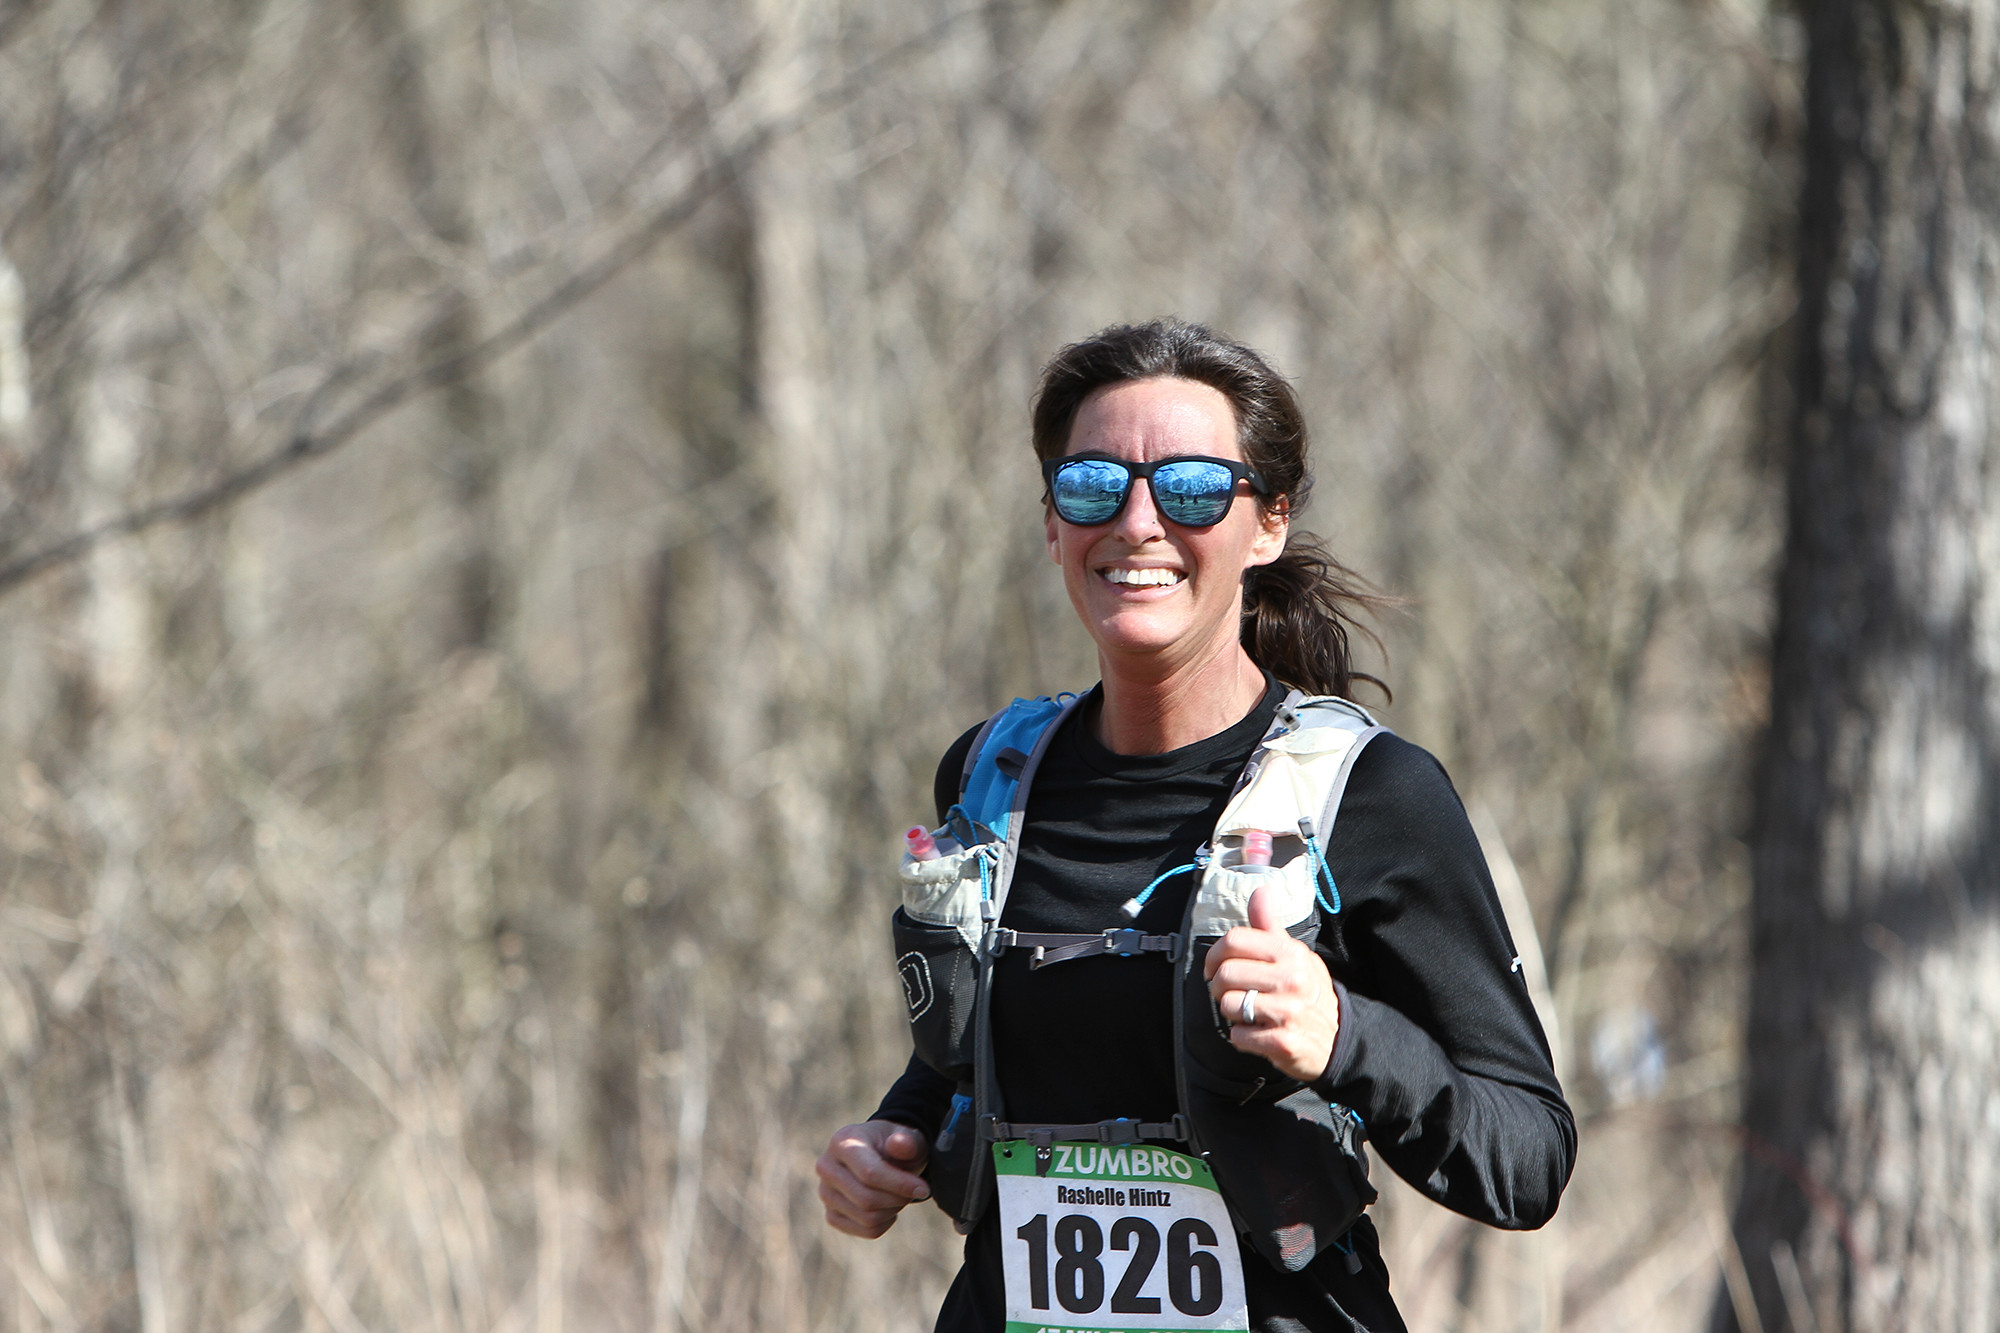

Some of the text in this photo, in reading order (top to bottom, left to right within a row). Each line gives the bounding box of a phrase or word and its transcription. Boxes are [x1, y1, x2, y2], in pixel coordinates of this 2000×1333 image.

[1055, 1145, 1193, 1180] ZUMBRO
[1057, 1185, 1171, 1207] Rashelle Hintz
[1017, 1214, 1223, 1316] 1826
